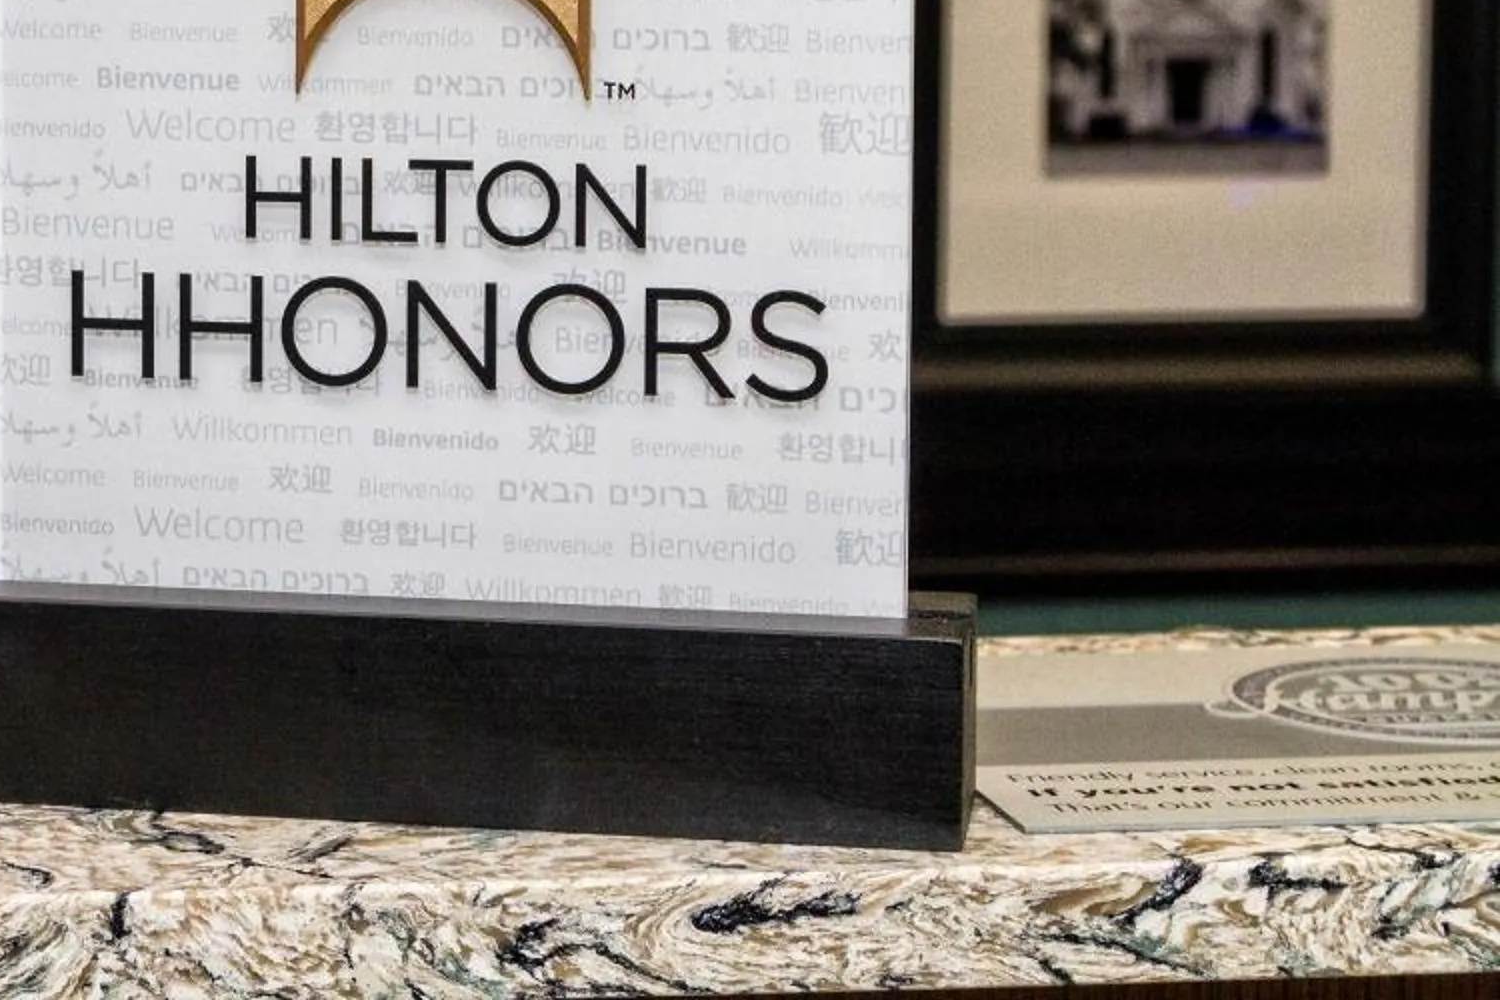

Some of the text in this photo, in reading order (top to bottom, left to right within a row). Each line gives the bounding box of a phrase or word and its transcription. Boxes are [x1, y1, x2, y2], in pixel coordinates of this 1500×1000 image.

[129, 23, 238, 43] Bienvenue
[357, 24, 475, 47] Bienvenido
[612, 27, 712, 51] ברוכים
[97, 66, 241, 92] Bienvenue
[413, 74, 506, 97] הבאים
[603, 81, 637, 100] TM
[125, 107, 295, 143] Welcome
[314, 110, 477, 145] 환영합니다
[497, 124, 790, 155] Bienvenue Bienvenido
[245, 154, 648, 250] HILTON
[722, 184, 843, 208] Bienvenido
[2, 208, 175, 240] Bienvenue
[71, 269, 830, 403] HHONORS
[172, 416, 499, 453] Willkommen Bienvenido
[527, 422, 597, 456] 欢迎
[631, 436, 743, 460] Bienvenue
[777, 431, 905, 464] 환영합니
[2, 464, 239, 492] Welcome Bienvenue
[268, 464, 333, 494] 欢迎
[358, 475, 474, 500] Bienvenido
[499, 479, 707, 509] ברוכים הבאים
[1, 505, 305, 544] Bienvenido Welcome
[338, 518, 477, 550] 환영합니다
[502, 530, 796, 564] Bienvenue Bienvenido
[182, 566, 369, 593] ברוכים הבאים
[466, 578, 641, 605] Willkommen
[1007, 770, 1134, 784] Friendly
[1028, 787, 1058, 798] If
[1075, 784, 1215, 799] you're
[1228, 781, 1302, 793] not
[1045, 792, 1444, 813] That's our commitment
